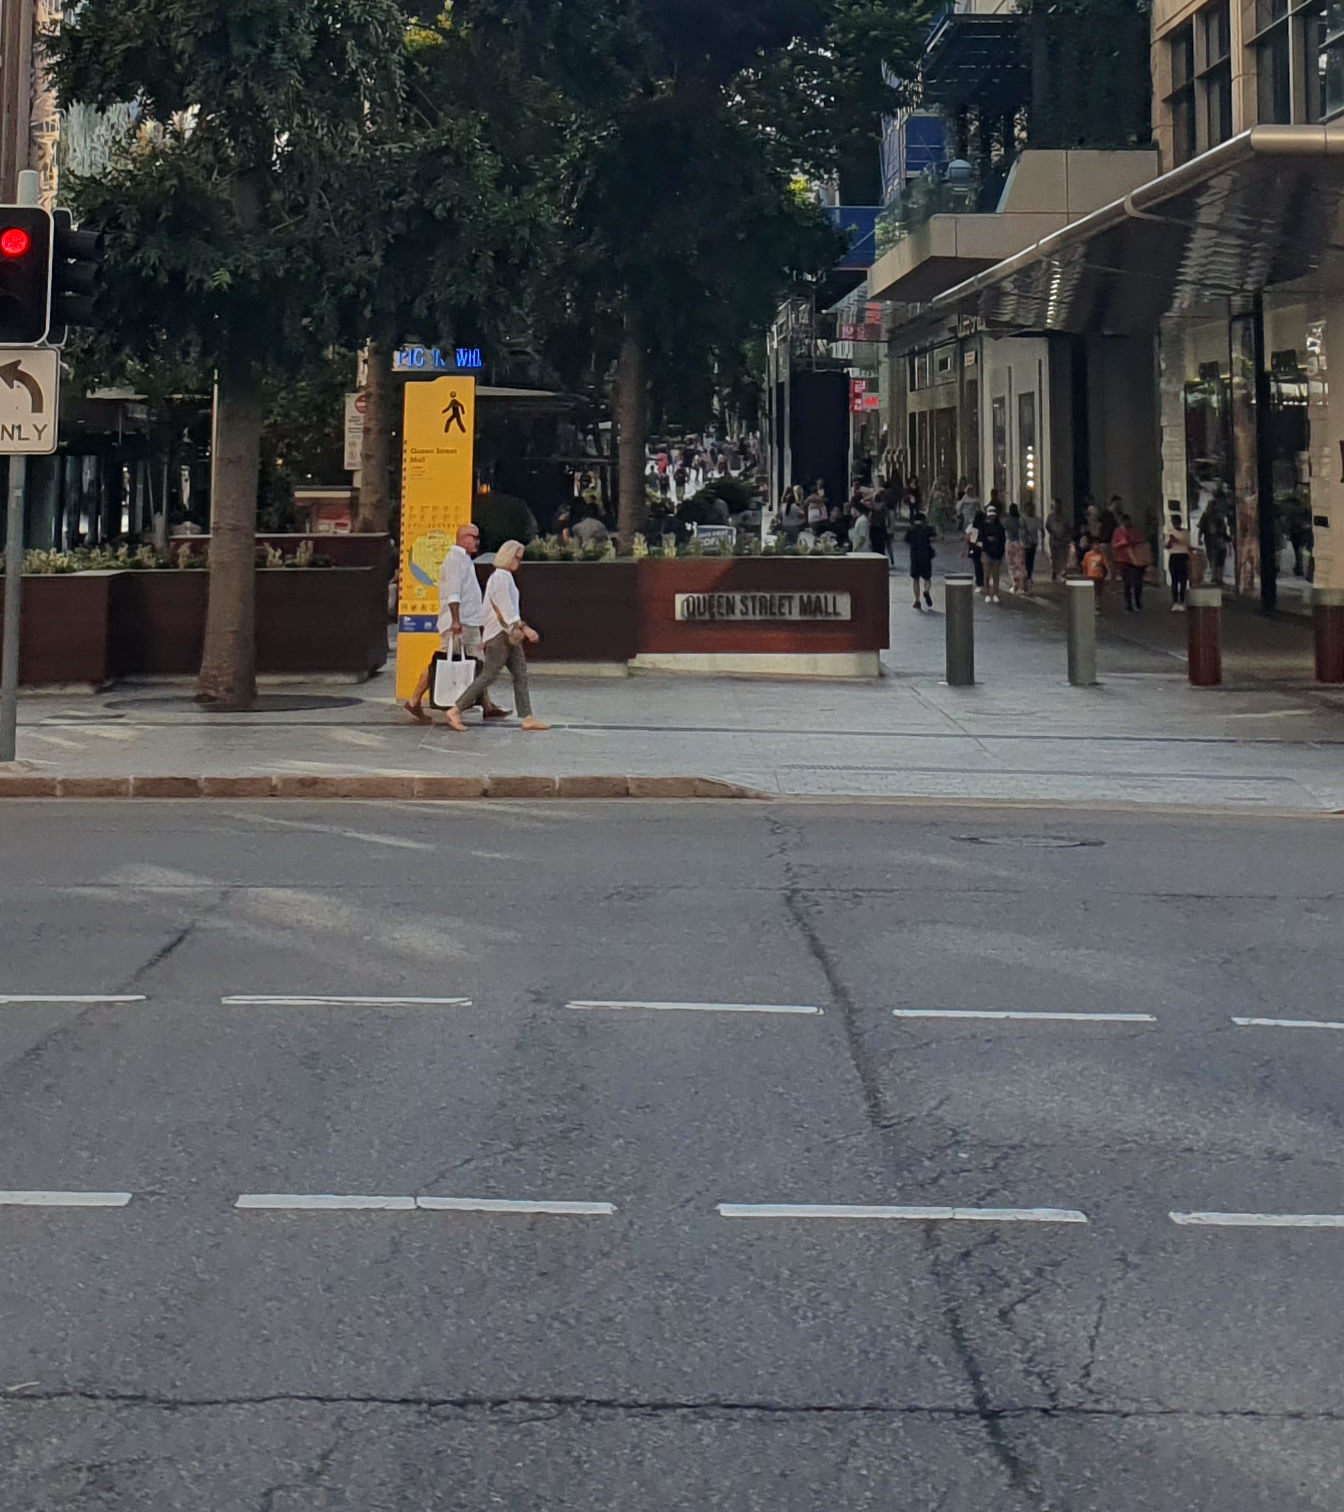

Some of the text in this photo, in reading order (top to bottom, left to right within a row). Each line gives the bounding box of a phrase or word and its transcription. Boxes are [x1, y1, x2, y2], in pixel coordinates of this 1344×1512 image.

[686, 595, 842, 616] QUEEN STREET MALL
